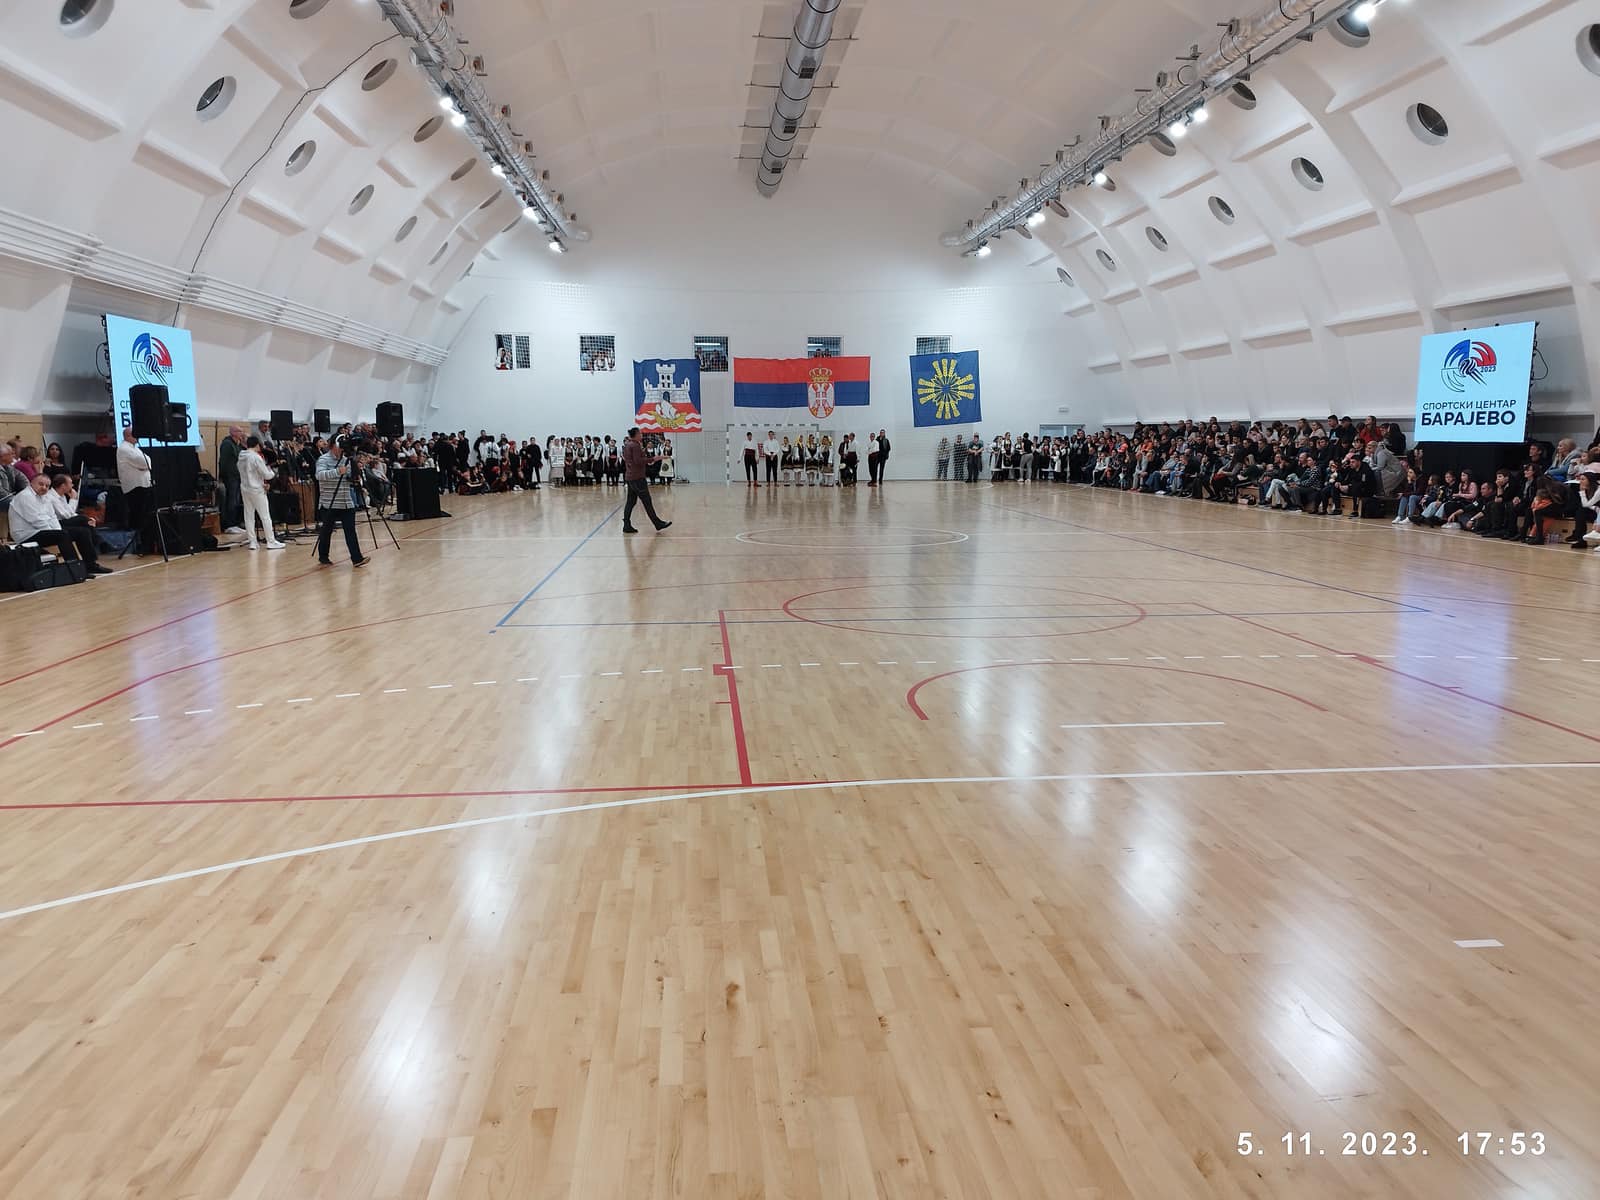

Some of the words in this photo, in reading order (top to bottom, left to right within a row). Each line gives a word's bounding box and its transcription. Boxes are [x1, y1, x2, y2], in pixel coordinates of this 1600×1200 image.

[1423, 401, 1473, 410] СПОРТСКИ
[1476, 399, 1516, 409] ЦЕНТАР
[1421, 410, 1516, 426] БАРАЈЕВО
